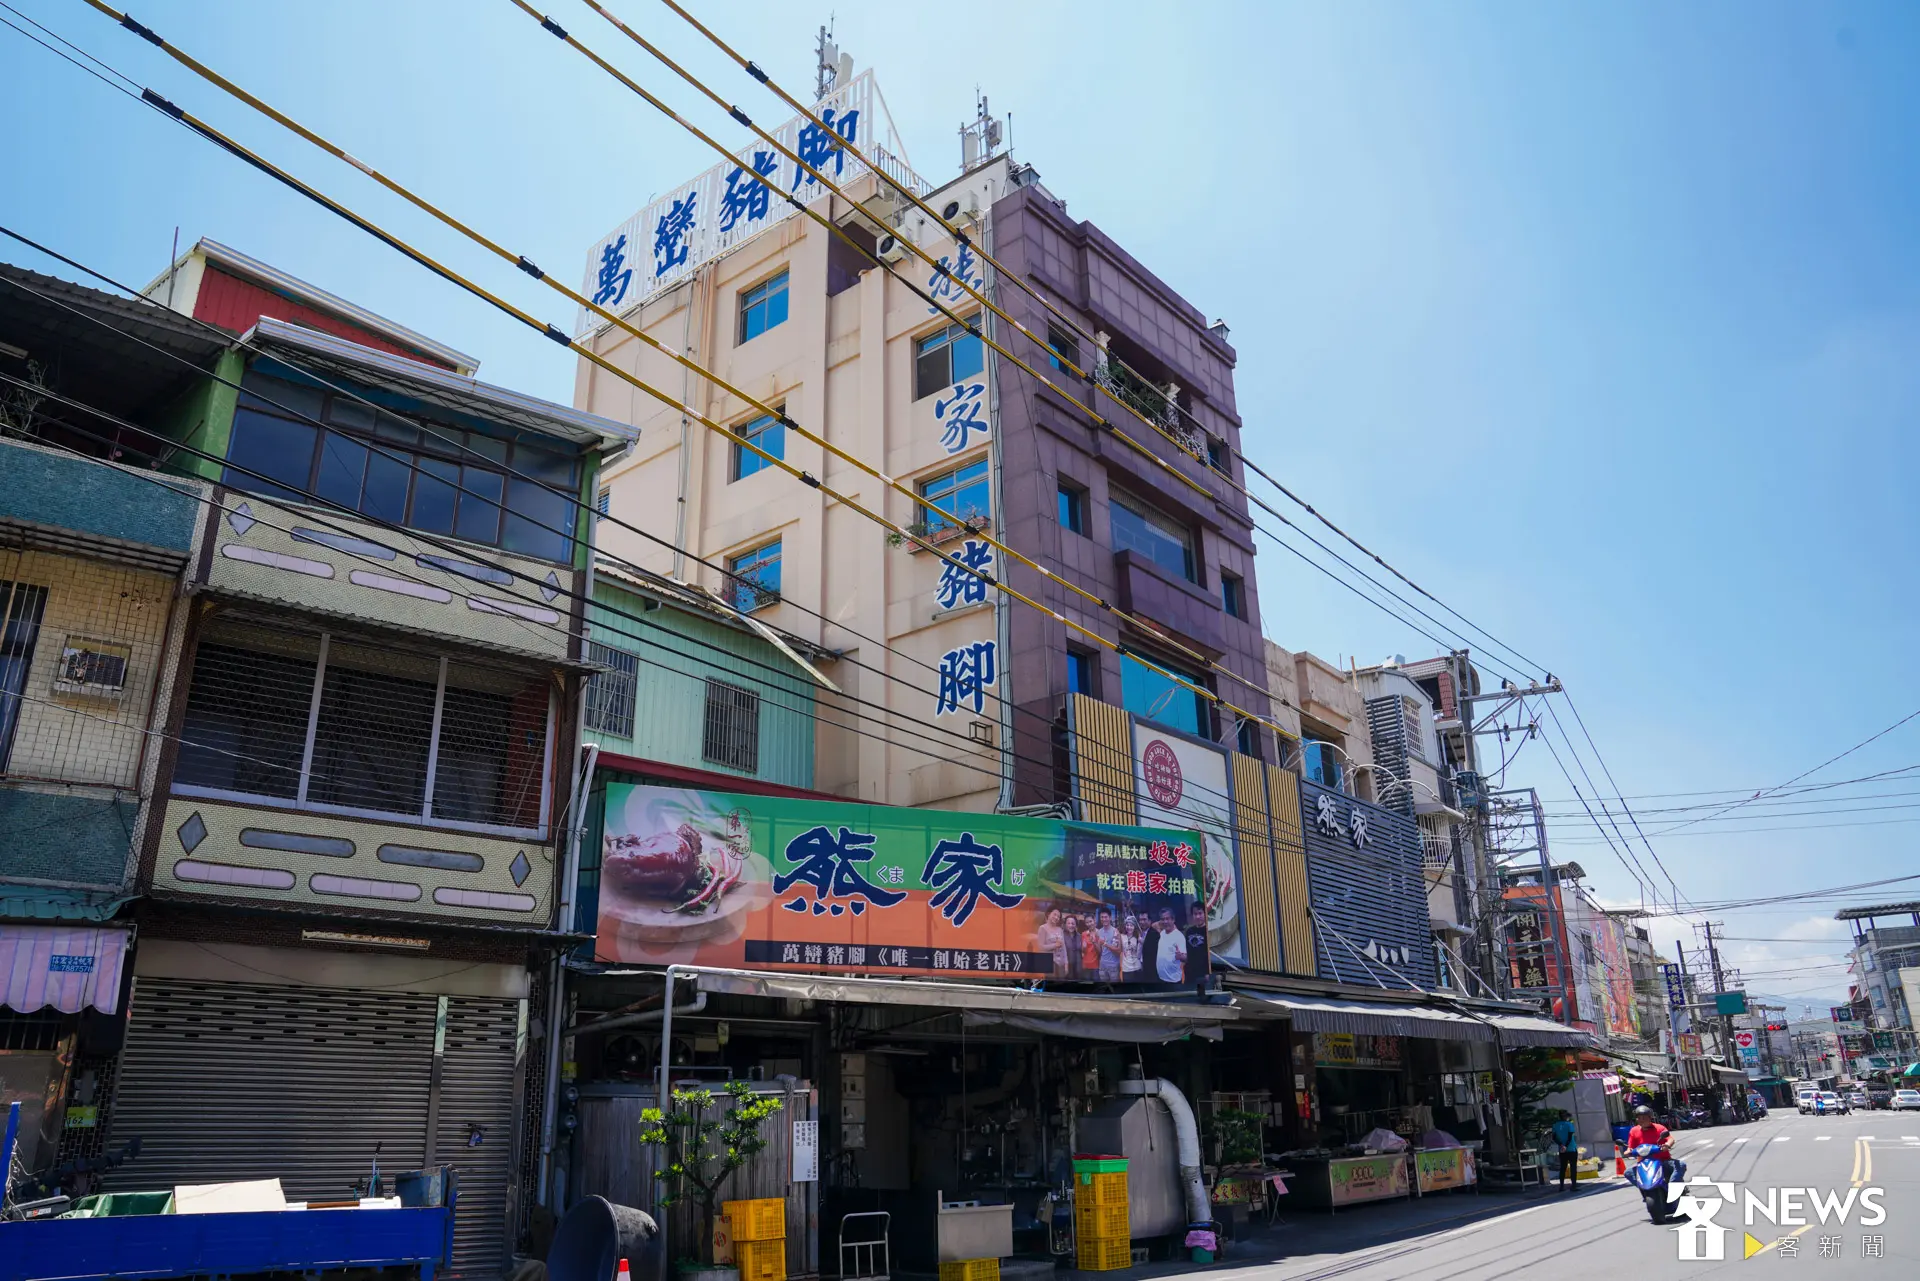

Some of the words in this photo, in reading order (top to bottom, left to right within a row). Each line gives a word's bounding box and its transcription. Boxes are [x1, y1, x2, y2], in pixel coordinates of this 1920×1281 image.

[1316, 794, 1373, 849] 熊家
[773, 825, 1026, 928] 熊家
[877, 865, 904, 883] くま
[1011, 868, 1026, 886] け
